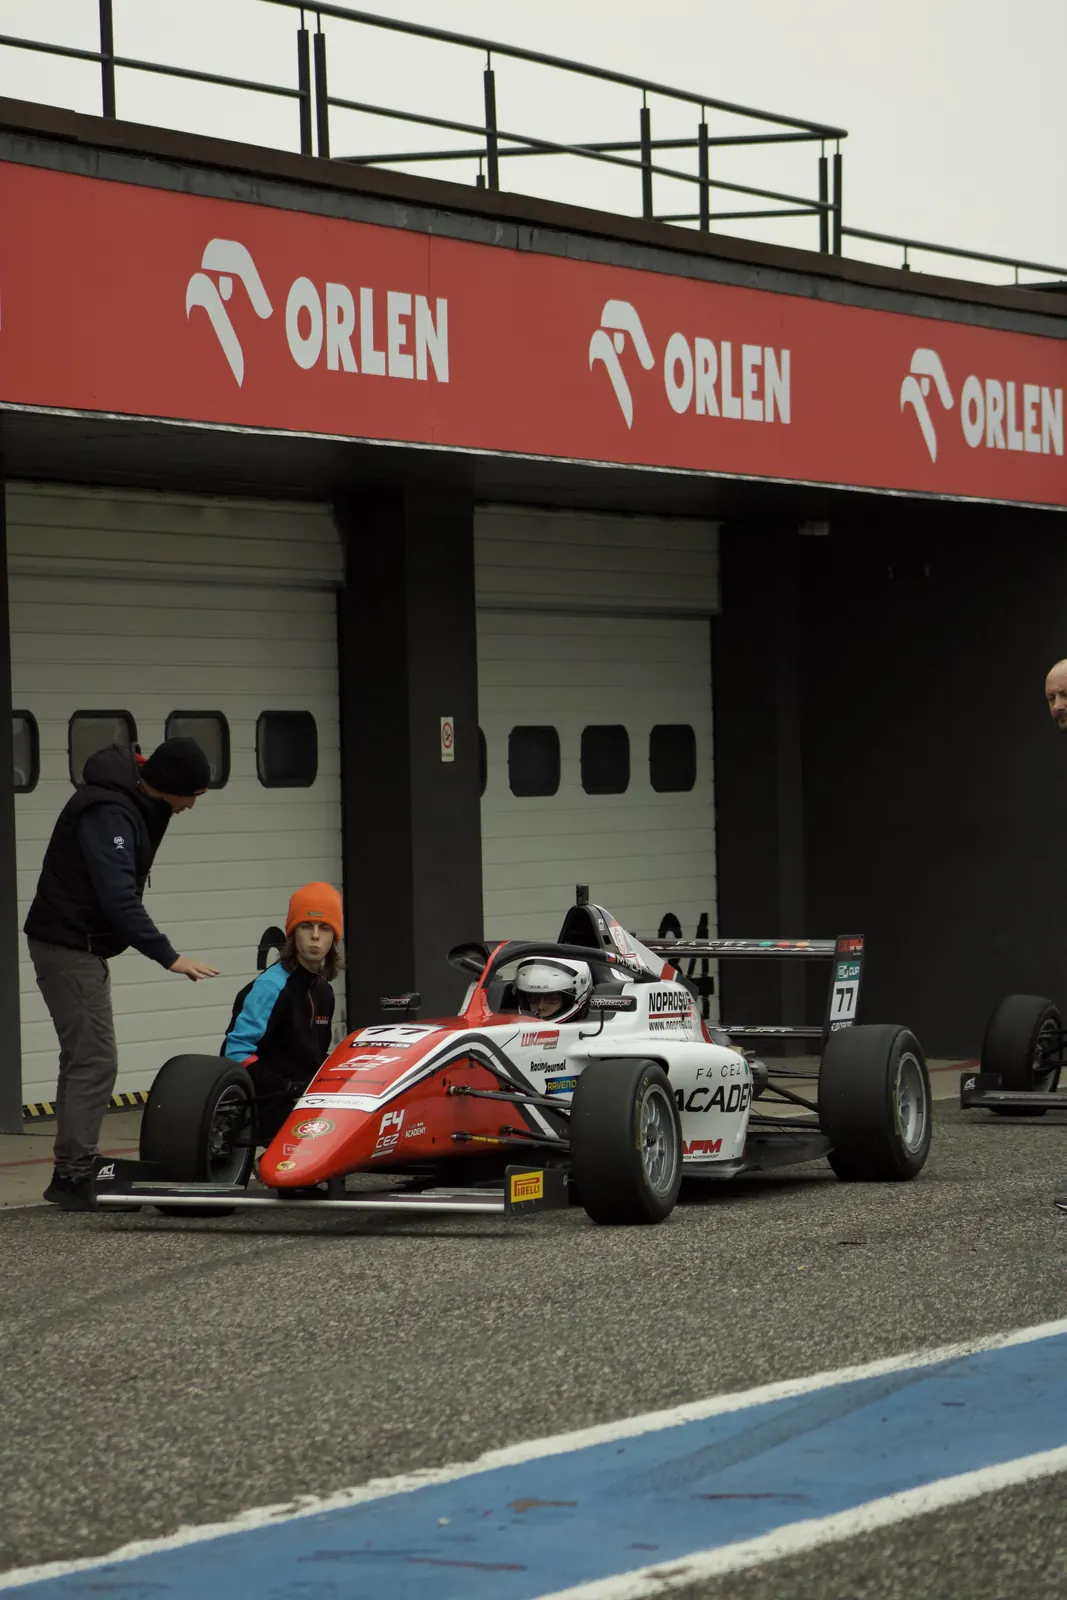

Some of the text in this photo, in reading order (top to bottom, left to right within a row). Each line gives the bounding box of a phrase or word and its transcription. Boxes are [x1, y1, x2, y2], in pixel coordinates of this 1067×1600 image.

[285, 276, 450, 384] ORLEN
[663, 332, 791, 425] ORLEN
[960, 375, 1064, 457] ORLEN
[836, 987, 854, 1012] 77
[366, 1027, 430, 1036] 77
[695, 1063, 741, 1080] F4 CEZ
[547, 1079, 577, 1090] RAVENO
[674, 1083, 752, 1113] ACADE
[378, 1109, 406, 1136] F4
[404, 1126, 427, 1138] ACADEMY
[375, 1133, 400, 1149] CEZ
[514, 1177, 541, 1197] PIRELLI
